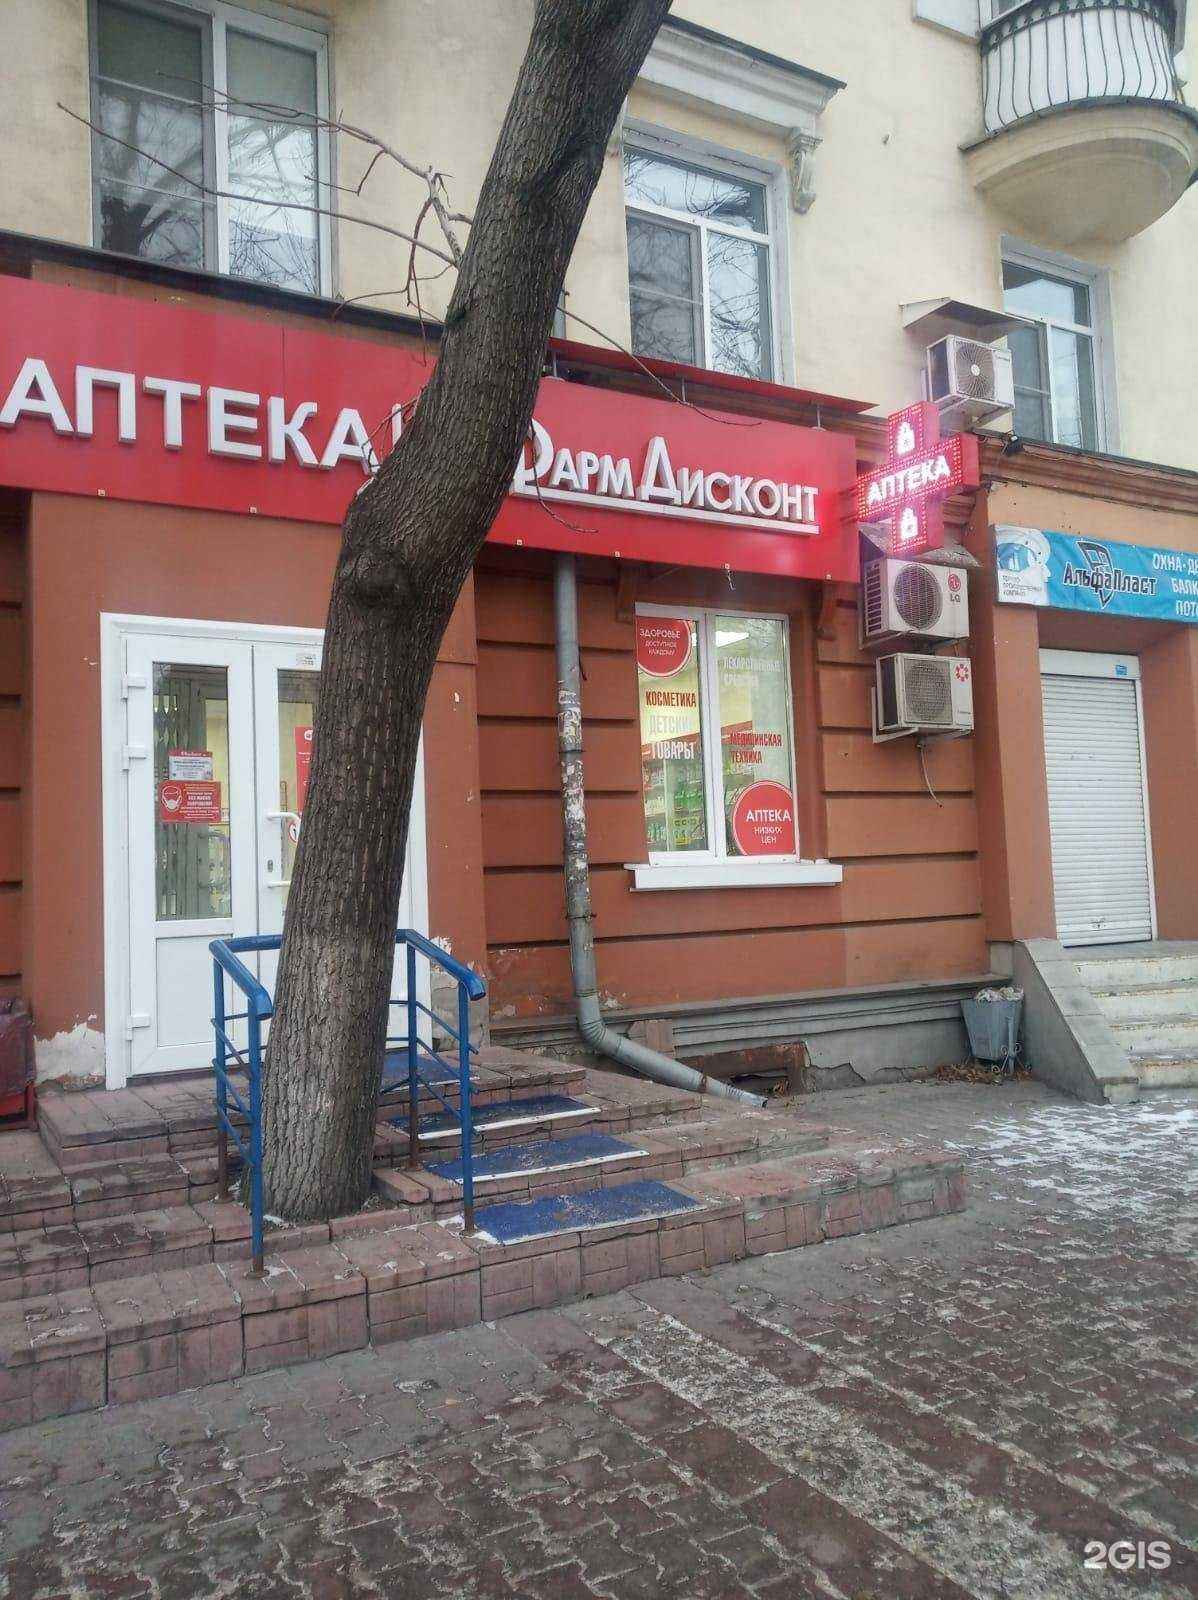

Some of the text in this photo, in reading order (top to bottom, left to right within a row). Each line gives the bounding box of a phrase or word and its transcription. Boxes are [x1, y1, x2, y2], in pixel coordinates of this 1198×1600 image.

[0, 358, 380, 475] АПТЕКА
[867, 454, 952, 505] АПТЕКА
[1063, 562, 1157, 596] АльфаПласт
[645, 690, 697, 707] КОСМЕТИКА
[649, 714, 696, 735] ДЕТСКИ
[651, 740, 695, 760] ТОВАРЫ
[746, 809, 791, 822] АПТЕКА
[761, 836, 777, 845] ЦЕН
